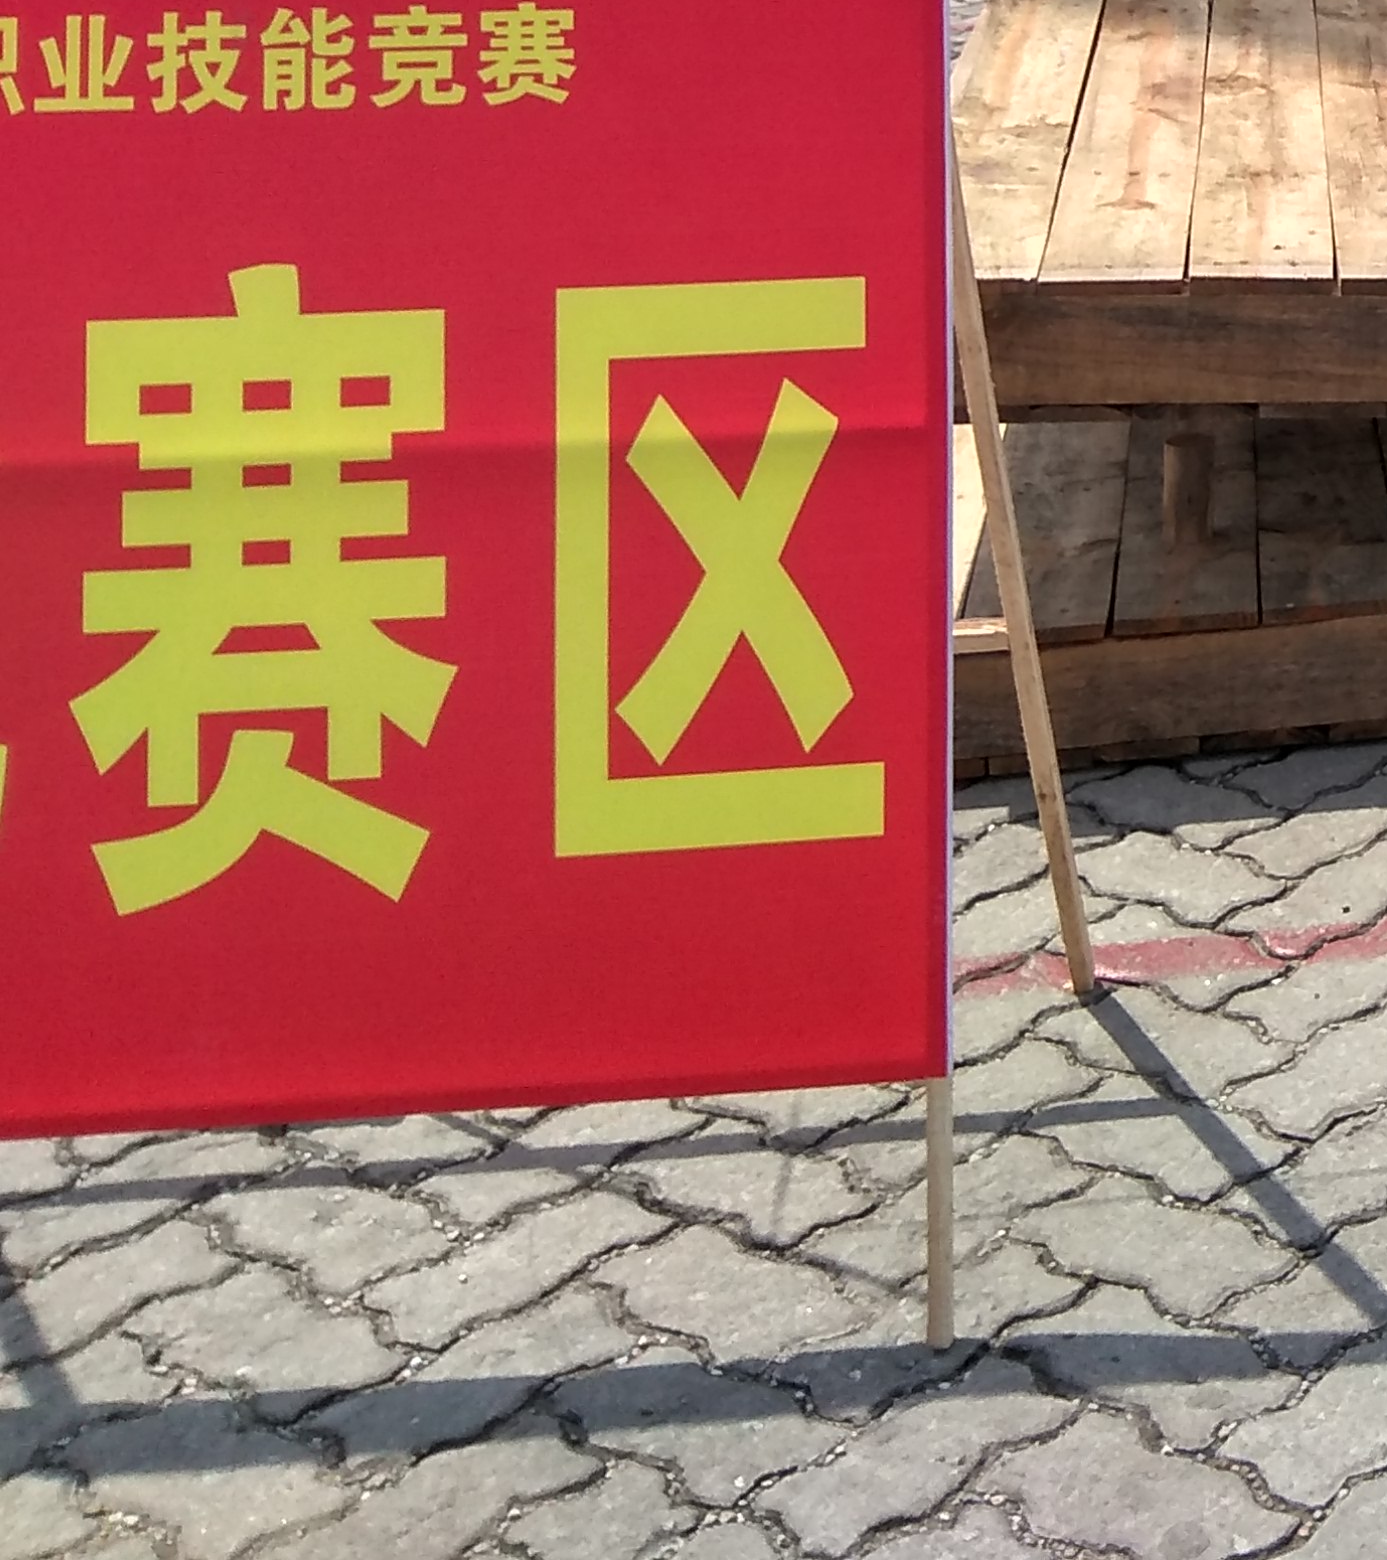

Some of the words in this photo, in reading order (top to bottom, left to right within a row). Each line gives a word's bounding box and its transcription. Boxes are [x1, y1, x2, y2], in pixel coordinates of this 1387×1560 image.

[0, 1, 577, 115] 业技能竞赛
[0, 263, 886, 917] 赛区
